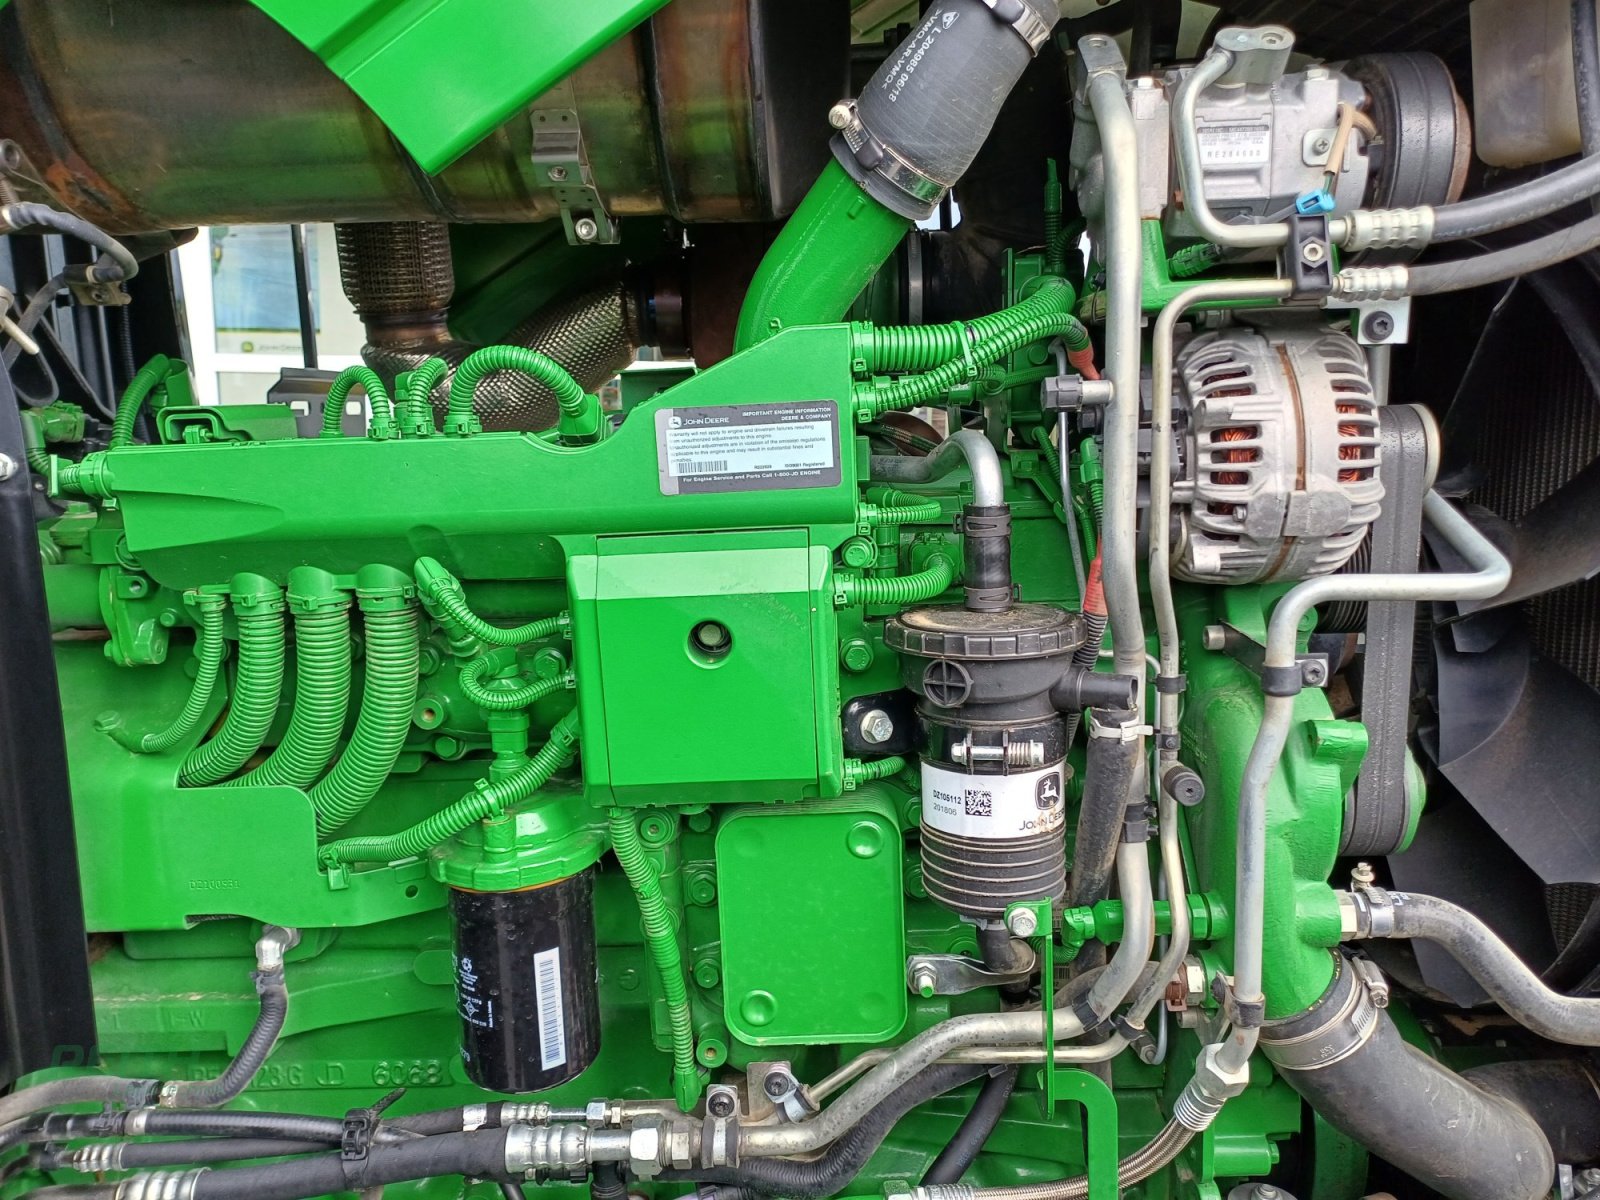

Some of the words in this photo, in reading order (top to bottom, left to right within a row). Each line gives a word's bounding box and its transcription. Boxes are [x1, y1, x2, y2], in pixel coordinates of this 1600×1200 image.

[906, 35, 934, 73] 204985
[889, 73, 908, 102] 06/18
[705, 416, 730, 424] DEERE
[933, 789, 961, 804] DZ105112
[933, 803, 957, 815] 201806
[316, 1062, 345, 1086] JD
[371, 1060, 444, 1086] 6068
